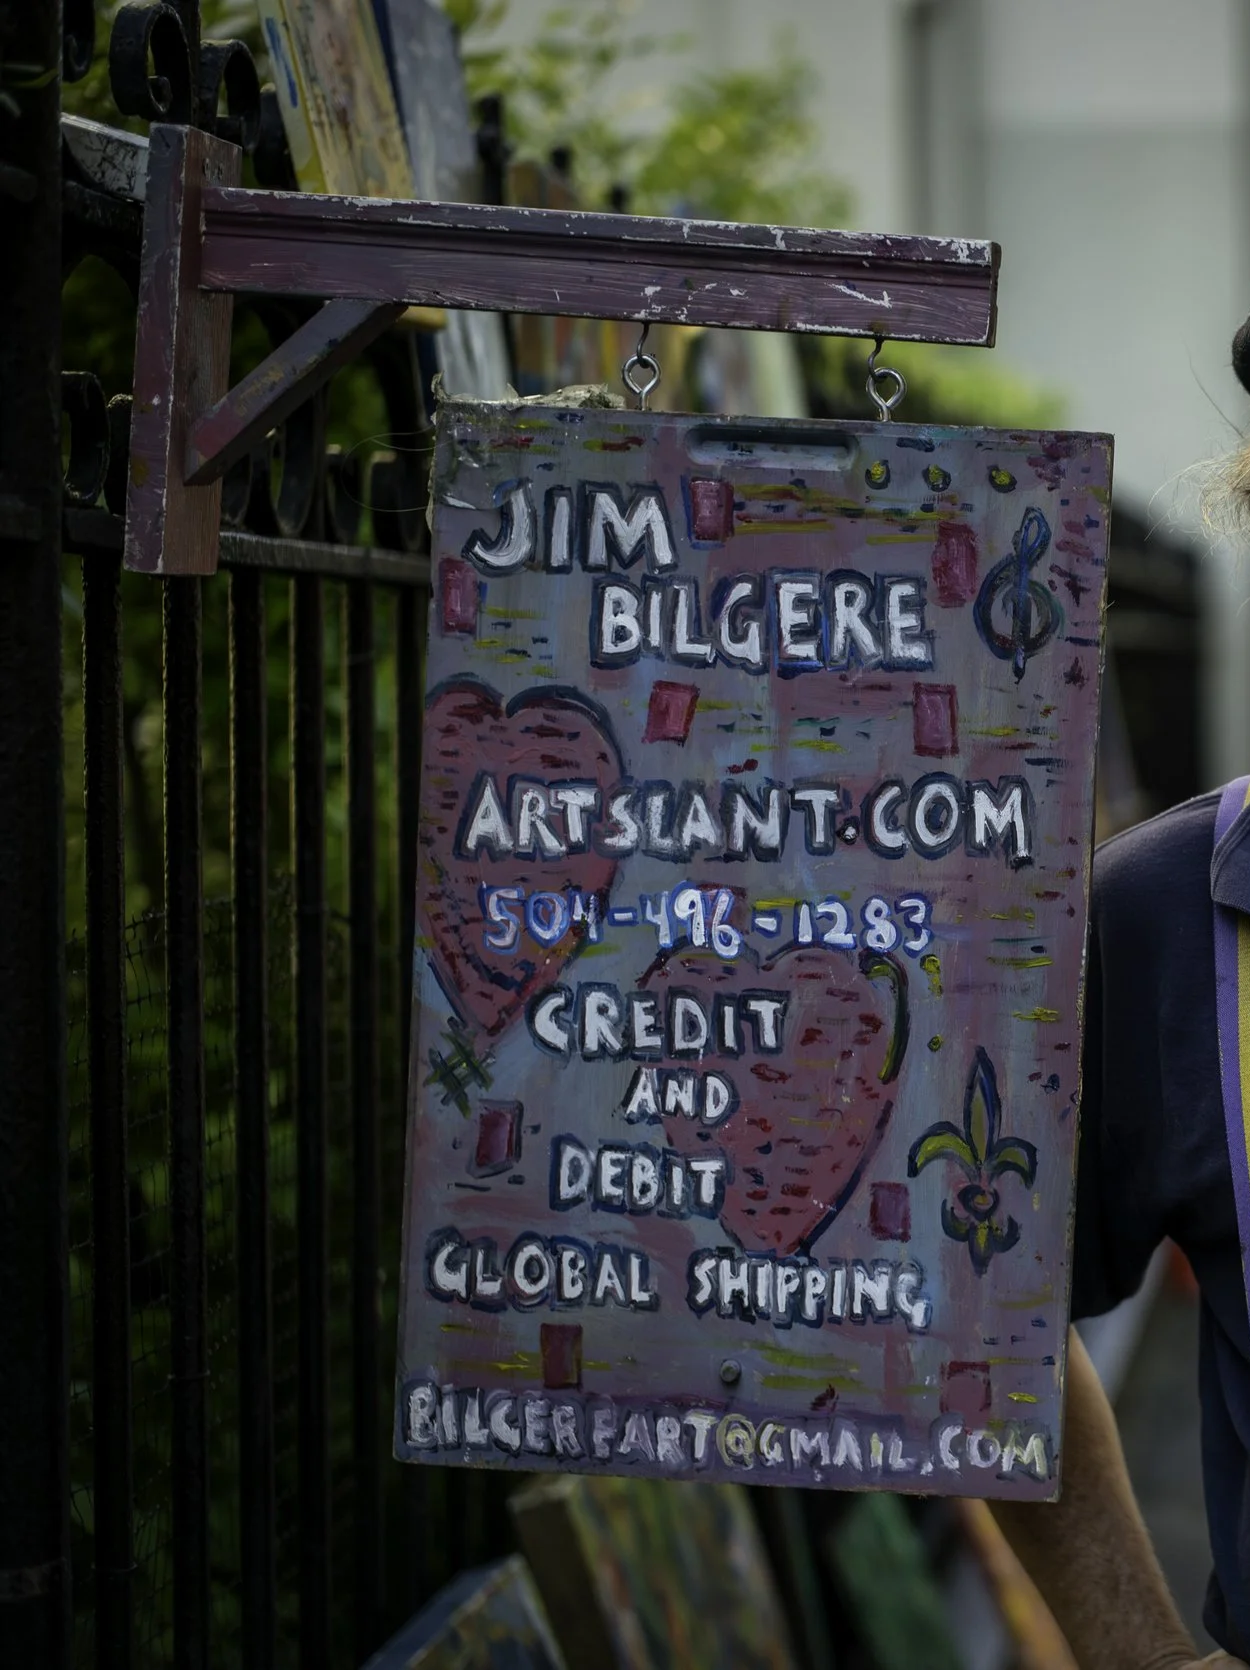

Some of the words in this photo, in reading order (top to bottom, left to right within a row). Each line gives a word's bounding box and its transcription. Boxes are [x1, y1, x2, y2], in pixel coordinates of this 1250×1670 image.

[470, 488, 674, 572] JIM
[598, 578, 928, 664] BILGERE
[462, 782, 1034, 862] ARTSLANT.COM
[482, 884, 930, 960] 504-496-1283
[533, 992, 785, 1053] CREDIT
[628, 1068, 730, 1123] AND
[557, 1143, 725, 1206] DEBIT
[432, 1241, 654, 1304] GLOBAL
[693, 1256, 932, 1330] SHIPPING
